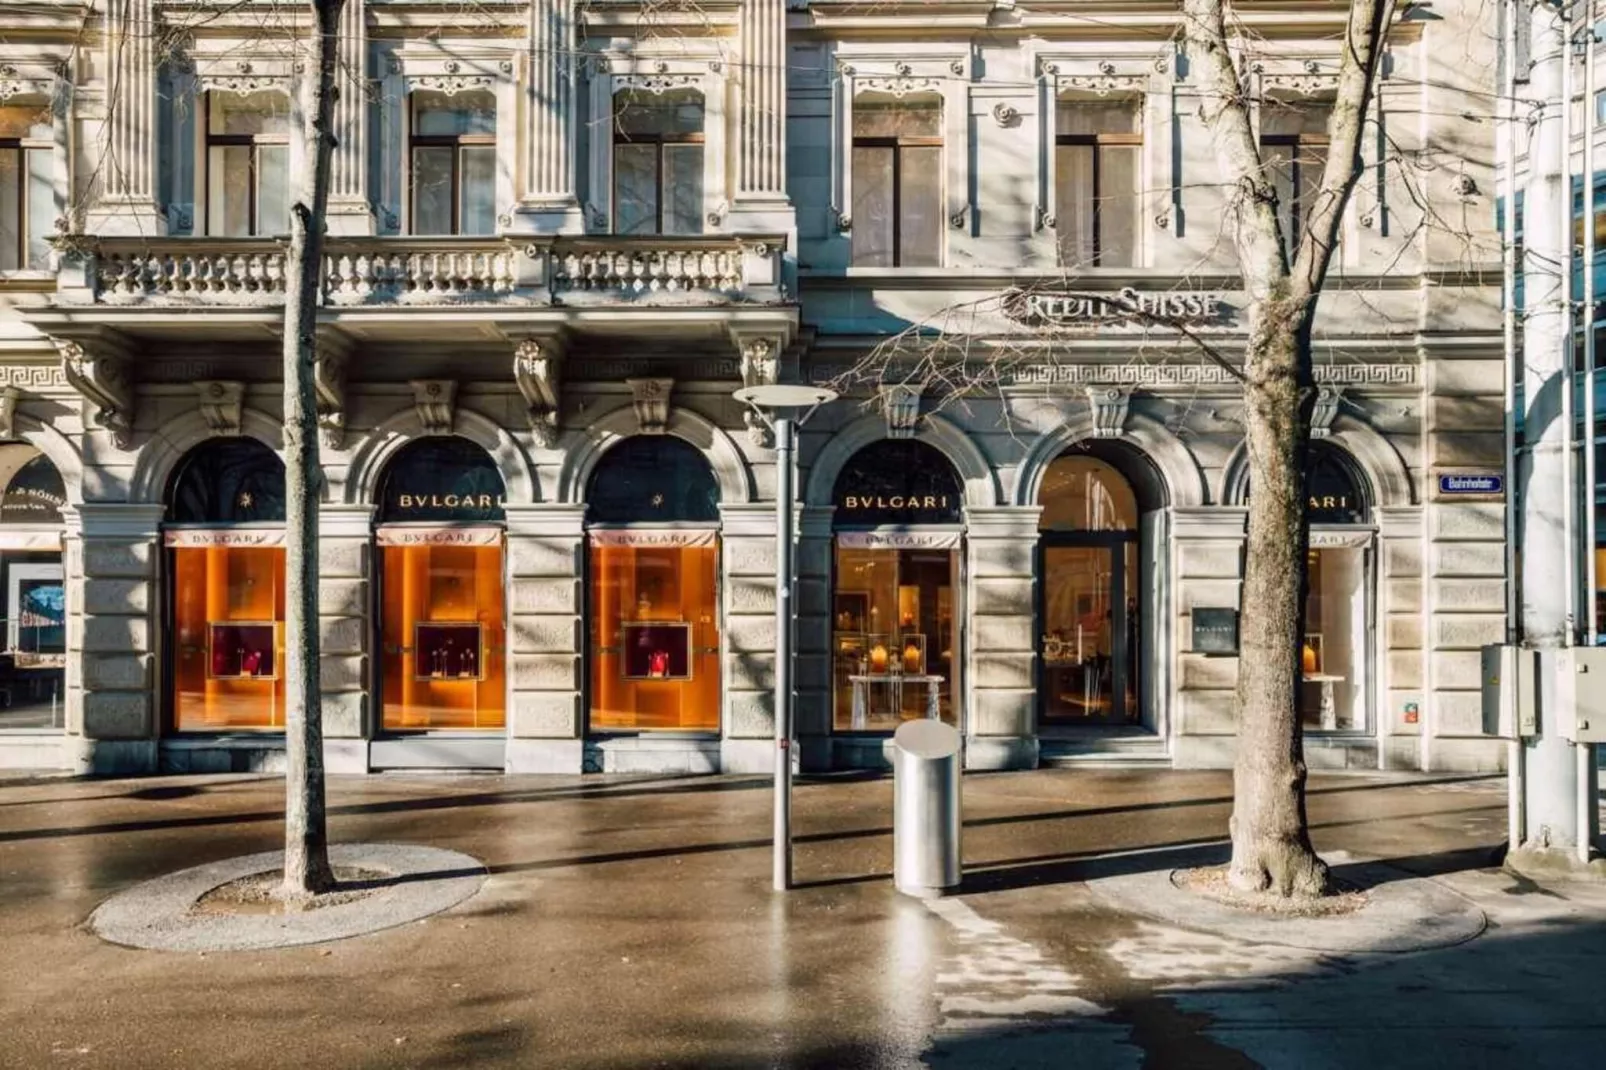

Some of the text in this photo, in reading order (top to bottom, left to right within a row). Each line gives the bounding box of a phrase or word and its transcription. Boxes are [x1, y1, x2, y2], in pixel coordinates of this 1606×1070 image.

[400, 494, 502, 507] BVLGARI
[846, 496, 946, 508] BVLGARI
[404, 533, 473, 542] BVLGARI
[618, 535, 687, 543] BVLGARI
